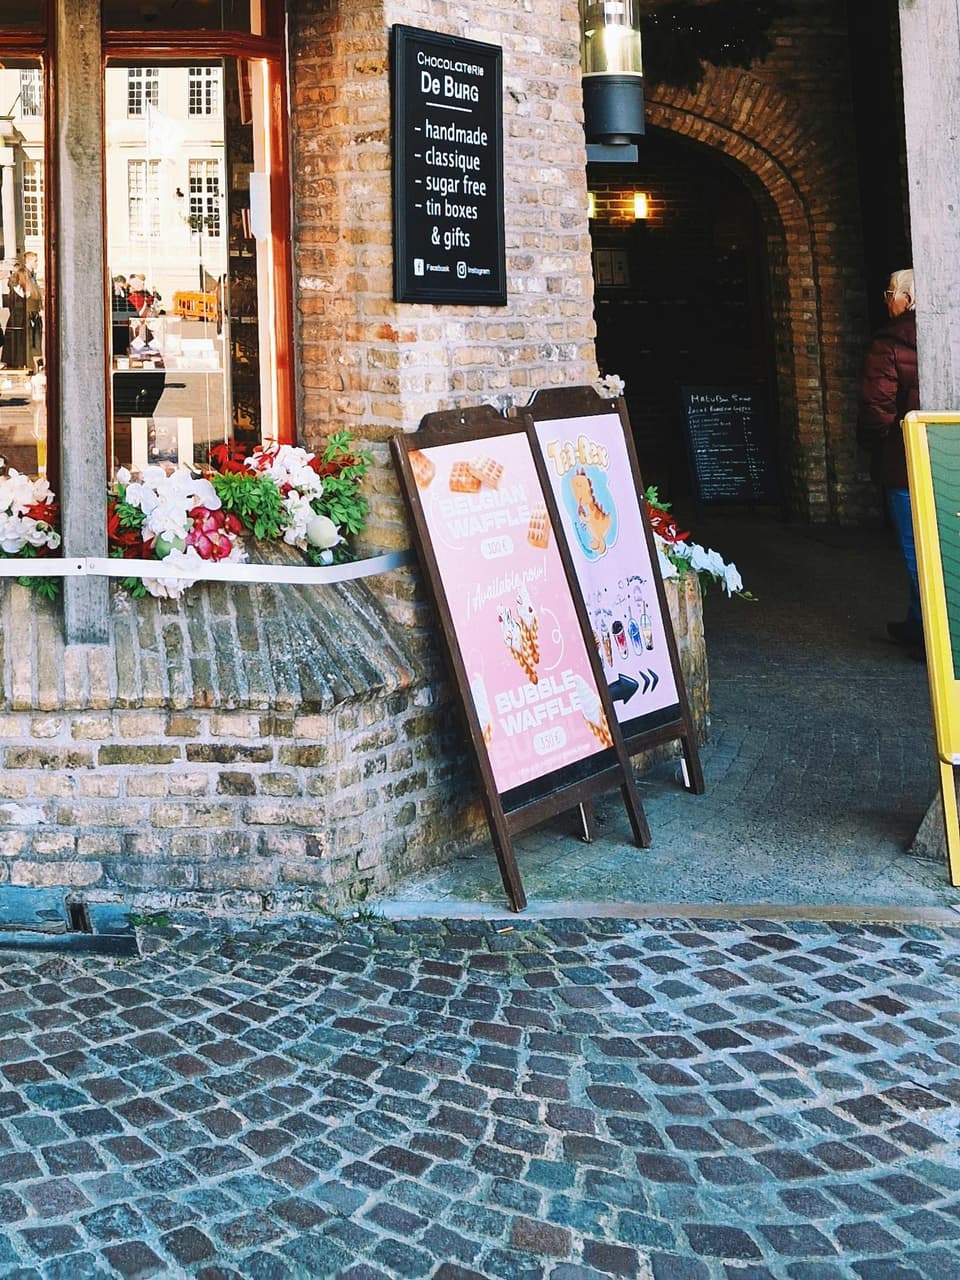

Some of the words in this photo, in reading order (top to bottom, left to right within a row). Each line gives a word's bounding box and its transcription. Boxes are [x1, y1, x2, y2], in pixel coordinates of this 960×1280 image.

[421, 70, 440, 95] De
[425, 118, 488, 146] handmade
[425, 145, 481, 173] classique
[426, 176, 460, 196] sugar
[463, 174, 487, 196] free
[426, 198, 441, 216] tin
[445, 198, 478, 219] boxes
[431, 226, 440, 245] &
[444, 227, 470, 250] gifts
[438, 484, 528, 519] BELGIAN
[447, 504, 530, 539] WAFFLE
[494, 668, 577, 714] BUBBLE
[498, 691, 583, 737] WAFFLE
